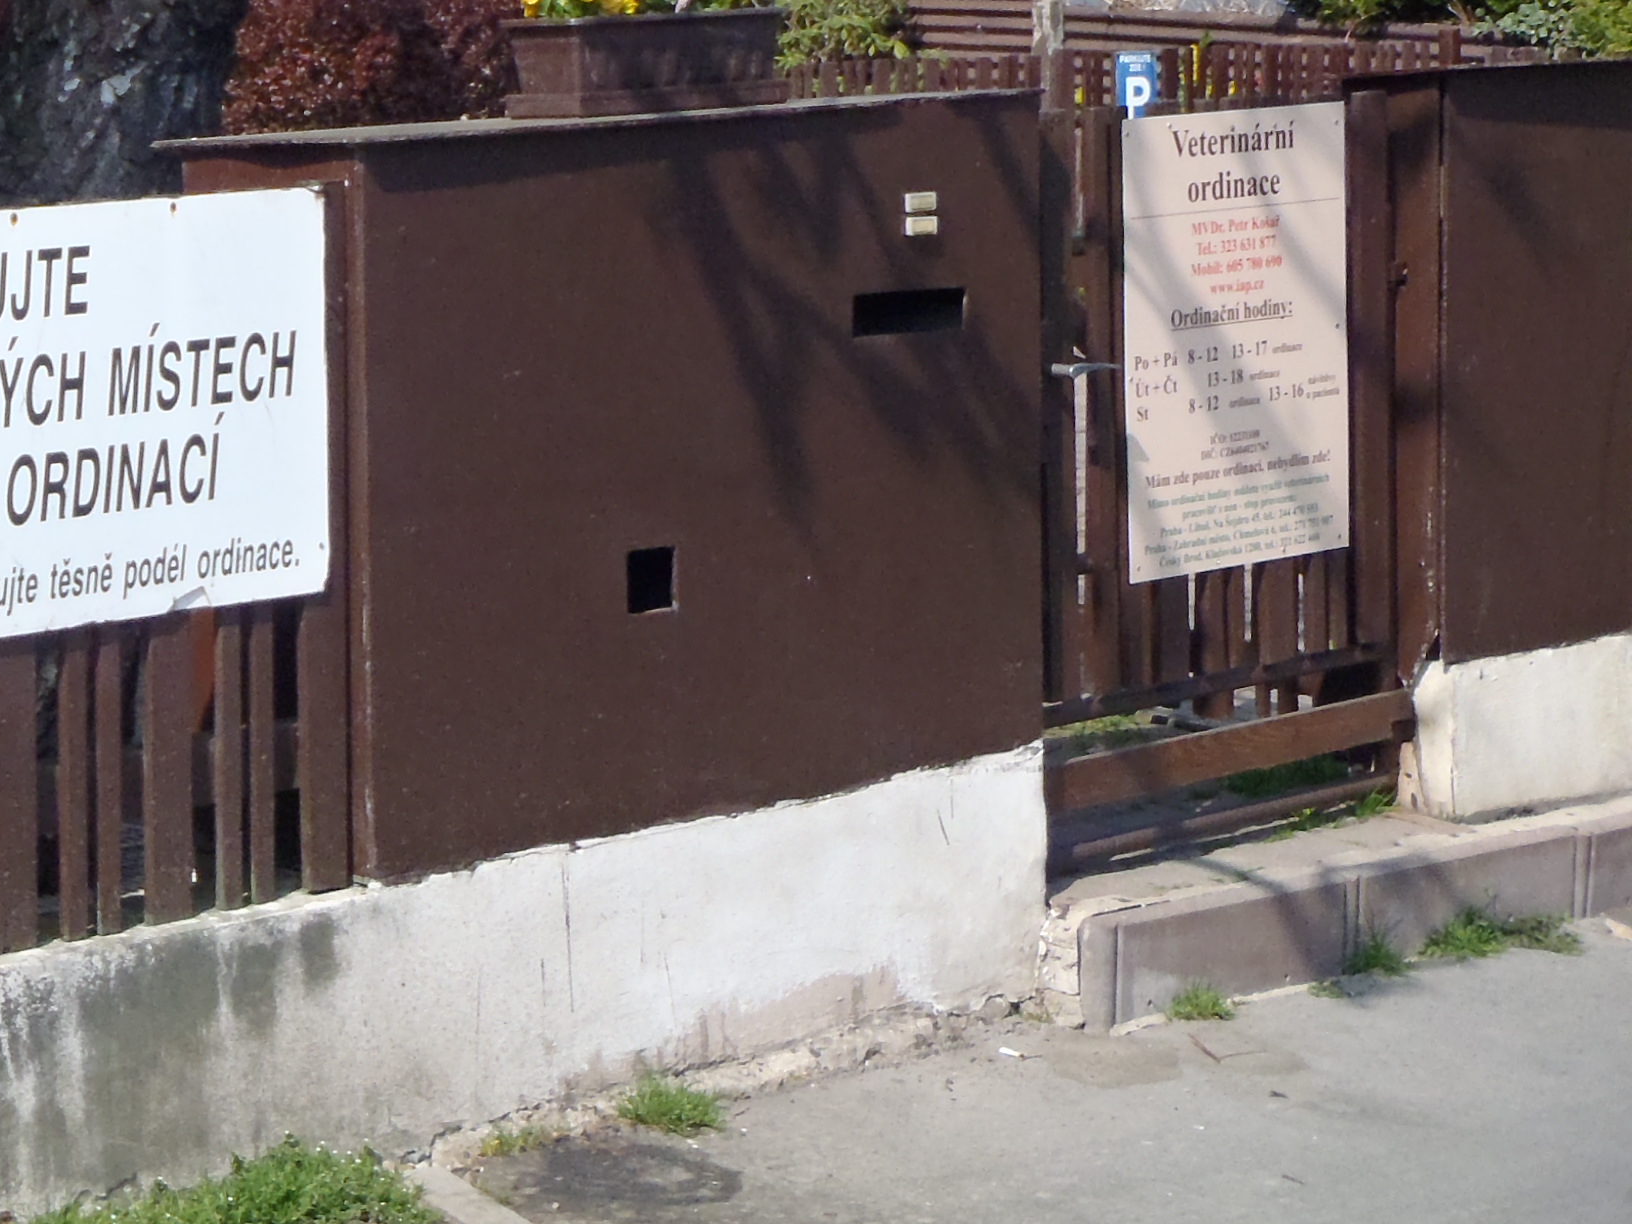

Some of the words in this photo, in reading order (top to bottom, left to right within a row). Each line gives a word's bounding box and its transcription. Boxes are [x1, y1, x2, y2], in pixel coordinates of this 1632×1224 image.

[1125, 76, 1151, 120] P
[1172, 120, 1294, 157] Veterinární
[1188, 171, 1280, 203] ordinace
[1191, 222, 1226, 237] MVDr.
[1229, 219, 1248, 233] Petr
[1171, 302, 1240, 328] Ordinační
[1244, 298, 1293, 320] hodiny:
[108, 322, 298, 418] MÍSTECH
[1134, 356, 1149, 371] Po
[1163, 352, 1178, 367] Pá
[1187, 349, 1195, 364] 8
[1206, 346, 1219, 362] 12
[1232, 343, 1244, 359] 13
[1255, 340, 1268, 356] 17
[1135, 381, 1150, 398] Út
[1163, 376, 1178, 394] Čt
[1207, 371, 1220, 387] 13
[1231, 369, 1244, 384] 18
[1136, 407, 1149, 422] St
[1188, 398, 1196, 414] 8
[1207, 395, 1220, 411] 12
[1269, 385, 1281, 402] 13
[1292, 383, 1304, 399] 16
[5, 412, 225, 527] ORDINACÍ
[49, 554, 113, 601] těsně
[123, 543, 187, 595] podél
[197, 536, 300, 581] ordinace.
